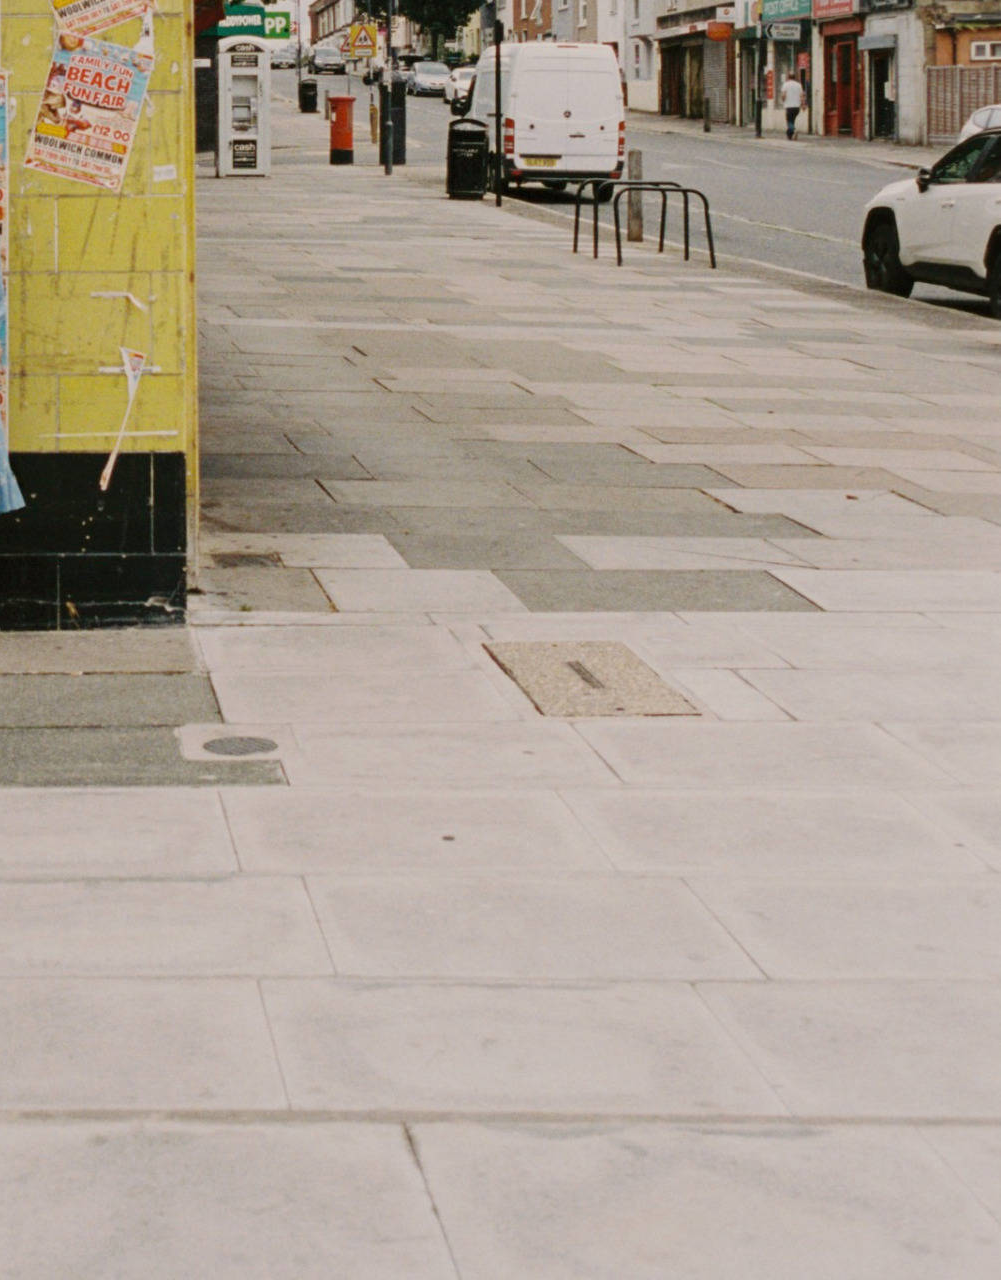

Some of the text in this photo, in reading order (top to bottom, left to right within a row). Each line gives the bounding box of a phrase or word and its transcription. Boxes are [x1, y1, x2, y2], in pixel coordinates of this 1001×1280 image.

[764, 1, 779, 15] POST
[70, 55, 133, 78] FAMILY FUN
[66, 65, 130, 94] BEACH
[33, 133, 123, 165] WOOLWICH COMMON
[234, 142, 256, 151] cash
